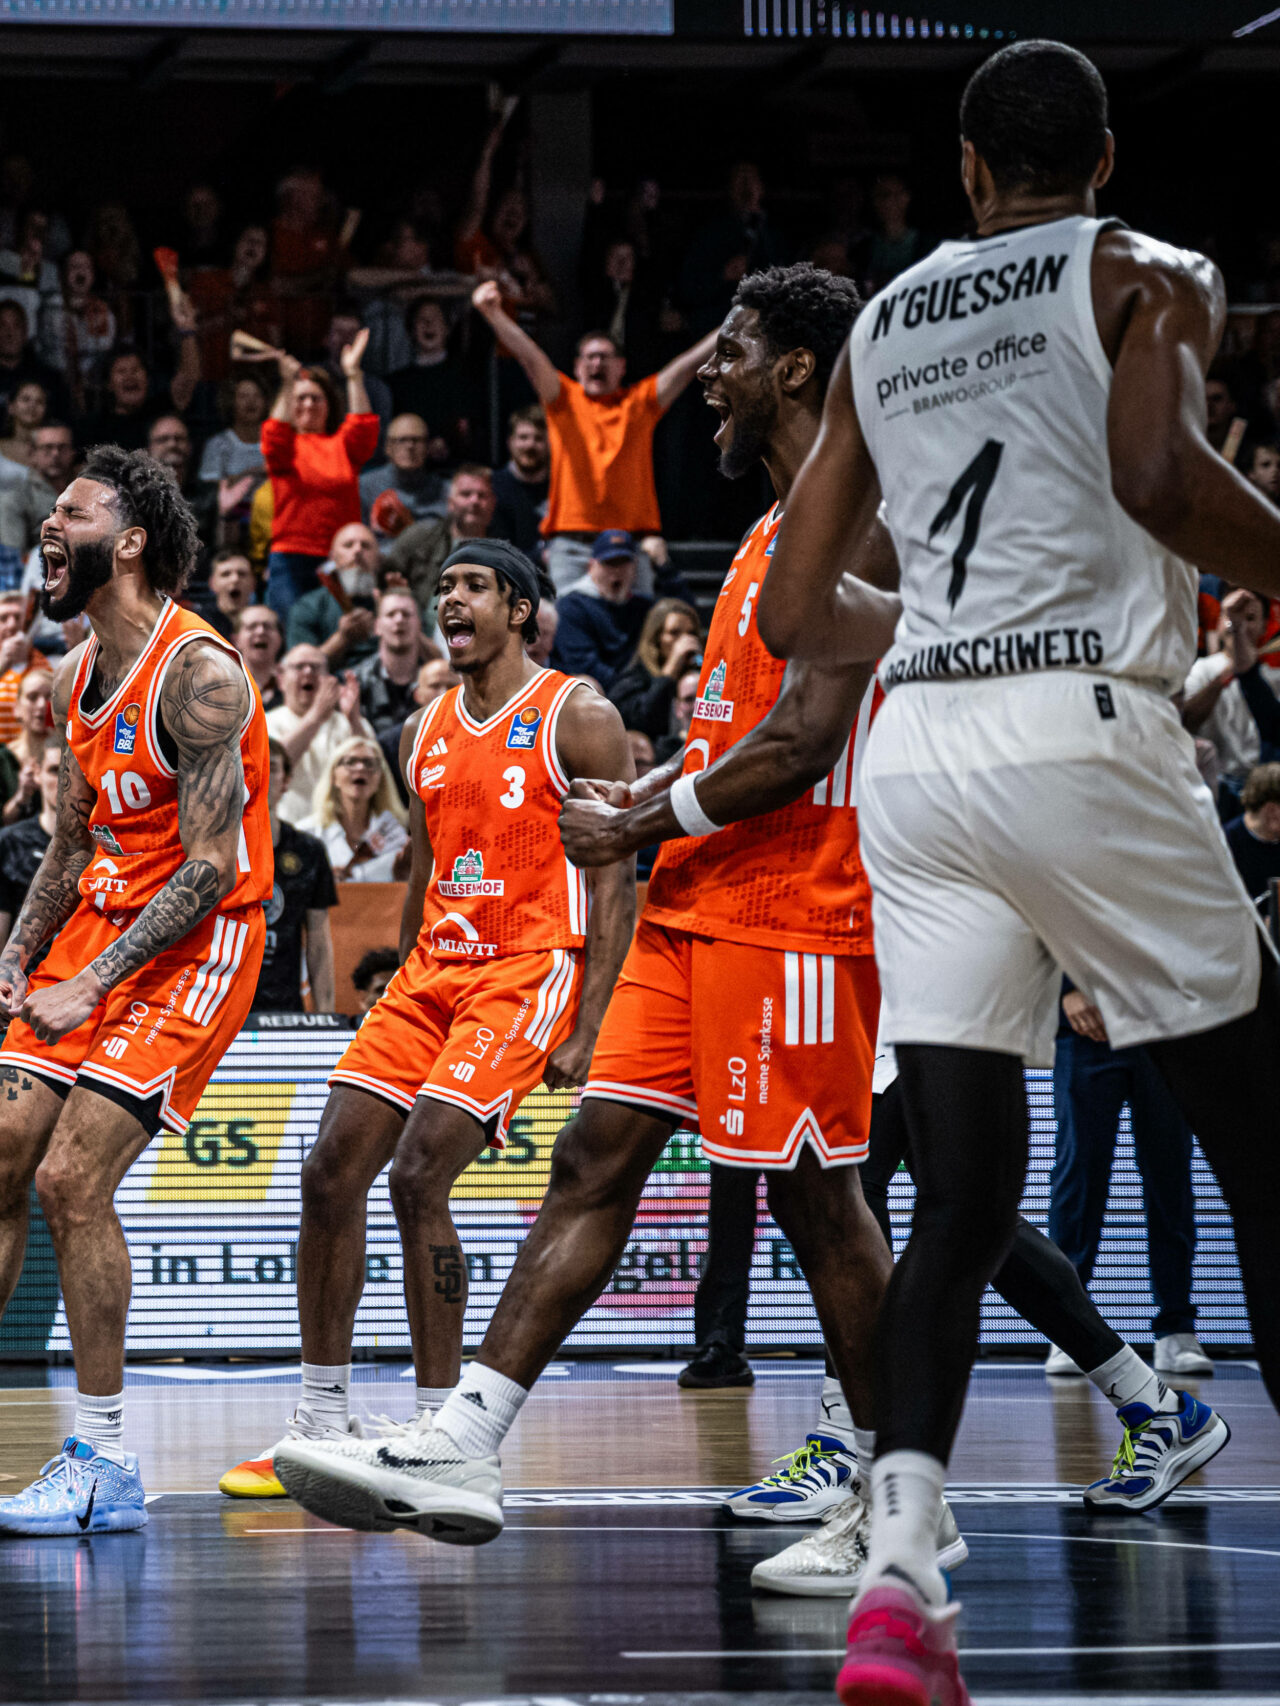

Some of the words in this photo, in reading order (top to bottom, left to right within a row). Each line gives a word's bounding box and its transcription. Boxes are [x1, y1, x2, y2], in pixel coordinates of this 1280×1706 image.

[872, 255, 1069, 341] N'GUESSAN
[877, 357, 968, 407] private
[977, 332, 1047, 370] office
[928, 438, 1005, 616] 1
[738, 582, 759, 637] 5
[101, 769, 151, 814] 10
[500, 765, 526, 809] 3
[438, 937, 498, 957] MIAVIT
[144, 1016, 166, 1046] meine
[160, 969, 191, 1017] Sparkasse
[490, 1042, 509, 1070] meine
[505, 998, 531, 1042] Sparkasse
[758, 997, 773, 1062] Sparkasse
[757, 1063, 770, 1104] meine
[185, 1118, 259, 1168] GS
[152, 1243, 198, 1283] in
